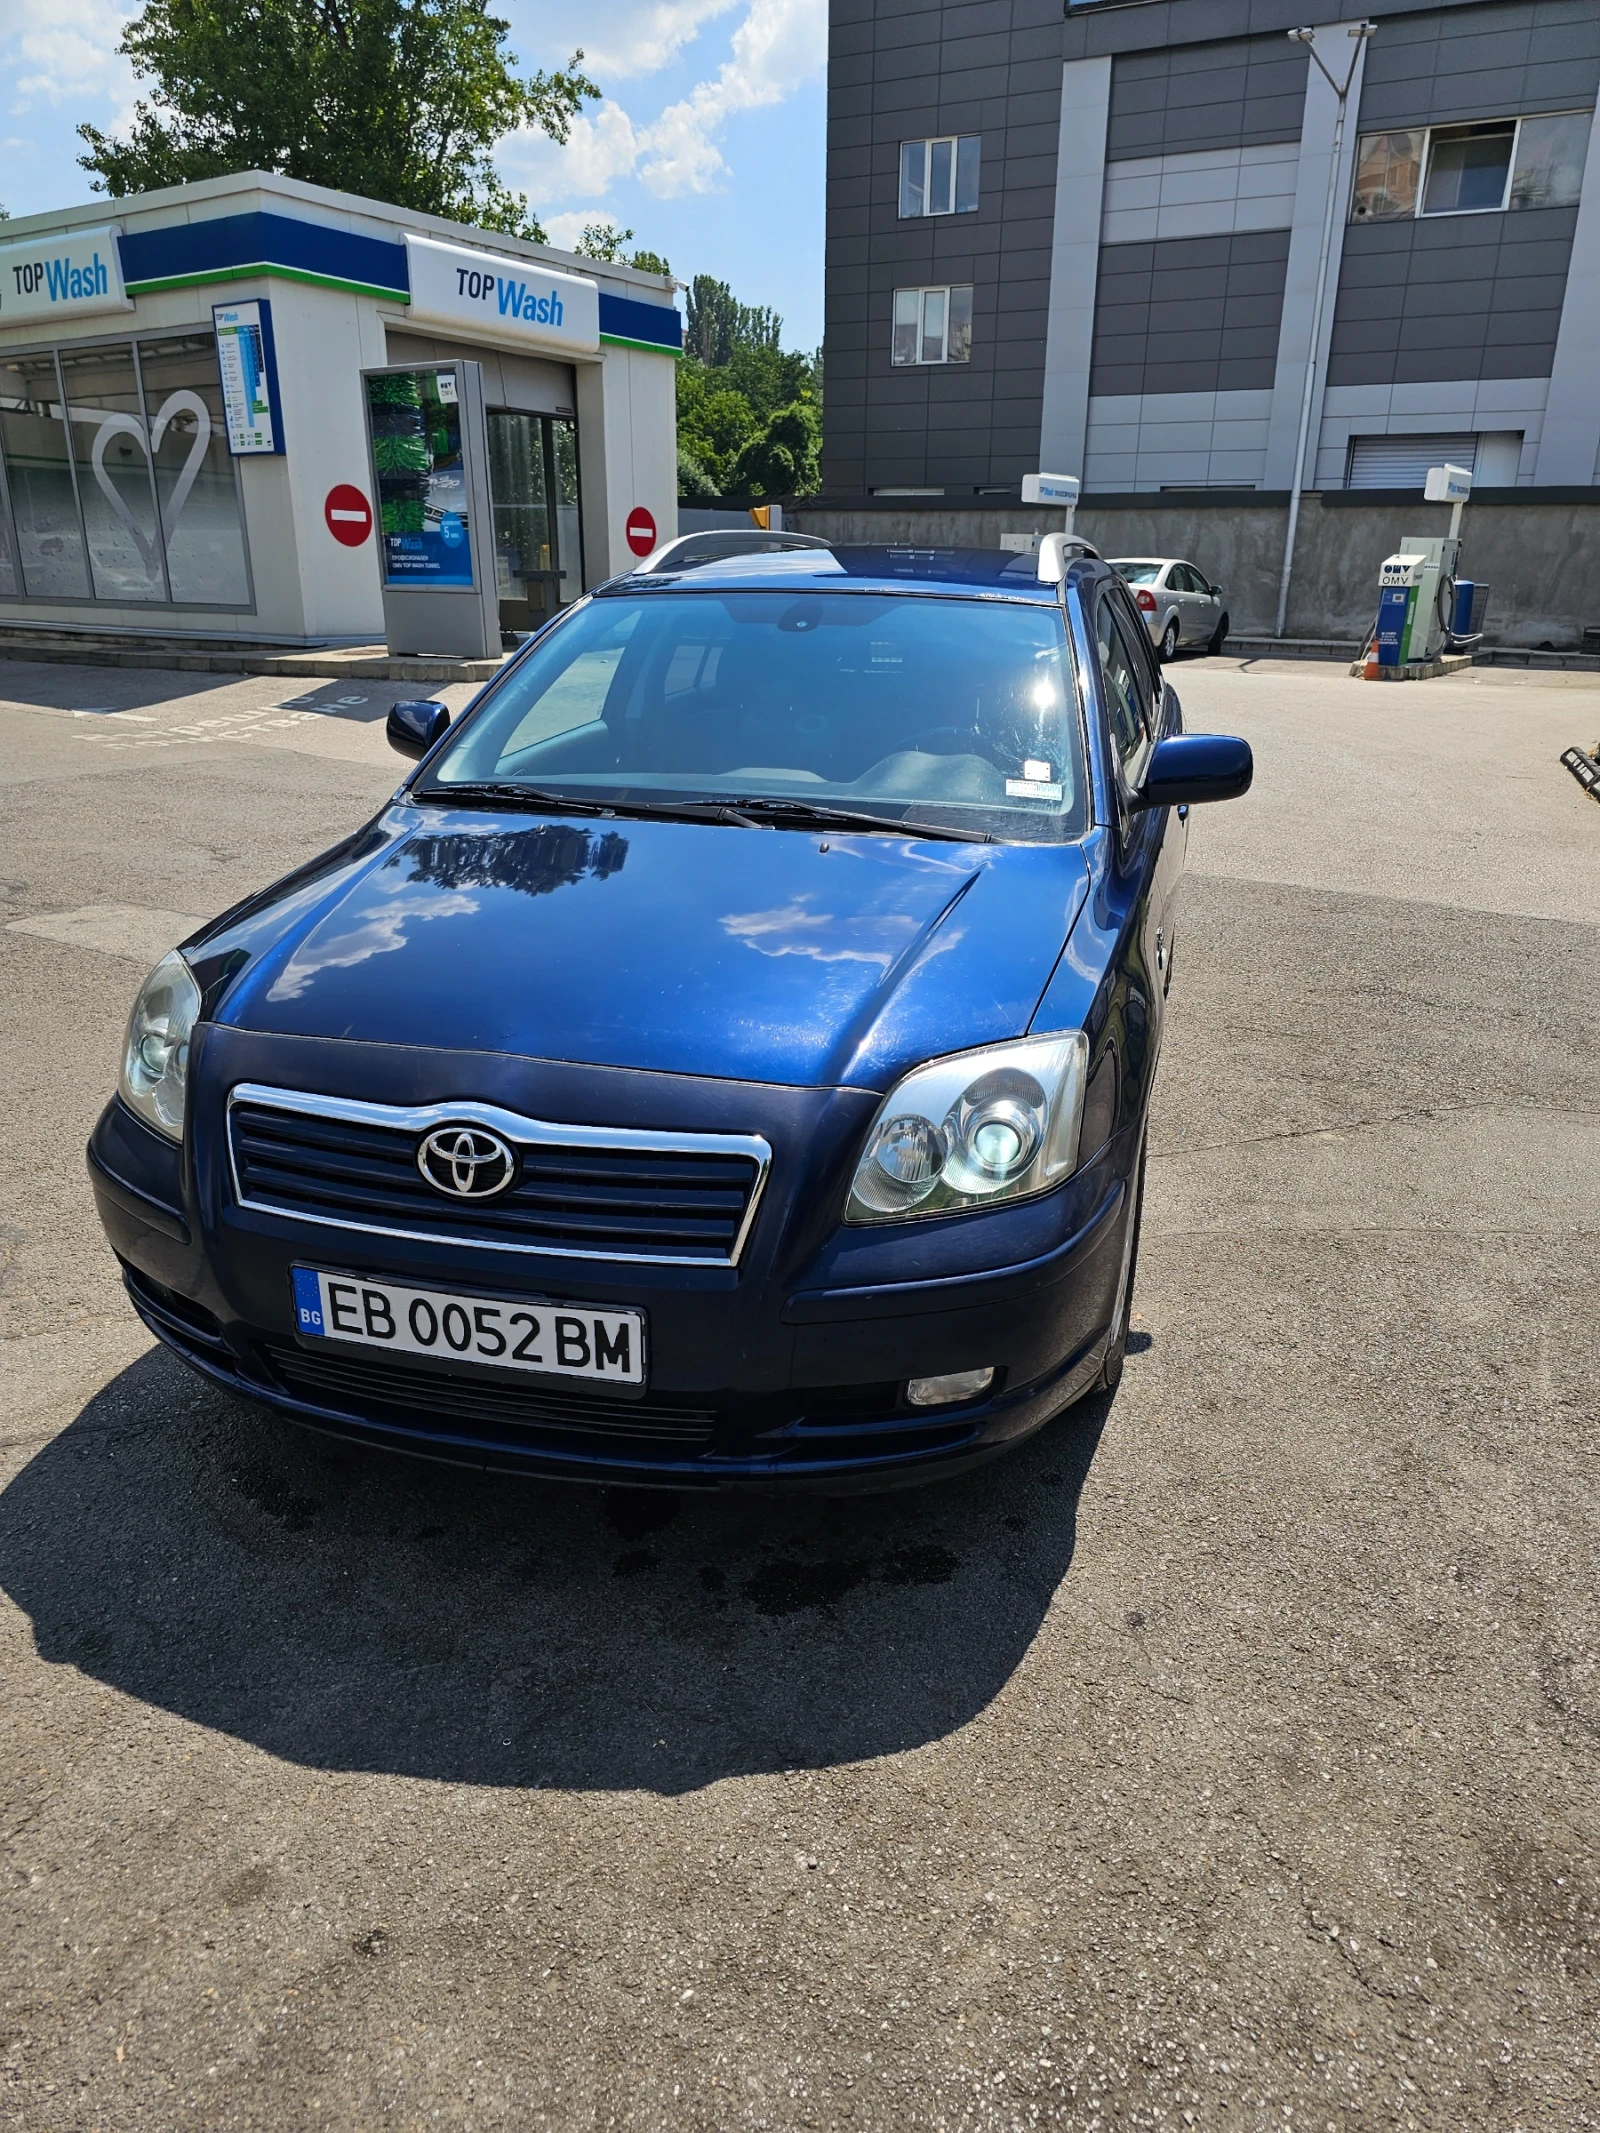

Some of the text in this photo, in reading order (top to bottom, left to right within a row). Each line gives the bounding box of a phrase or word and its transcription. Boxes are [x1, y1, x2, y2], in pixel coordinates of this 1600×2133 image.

[12, 252, 108, 302] TOP Wash
[456, 267, 564, 327] TOP Wash
[444, 526, 450, 539] 5
[390, 538, 401, 547] TOP
[1382, 576, 1409, 585] OMV
[300, 1307, 321, 1326] BG
[327, 1281, 631, 1373] EB 0052 BM
